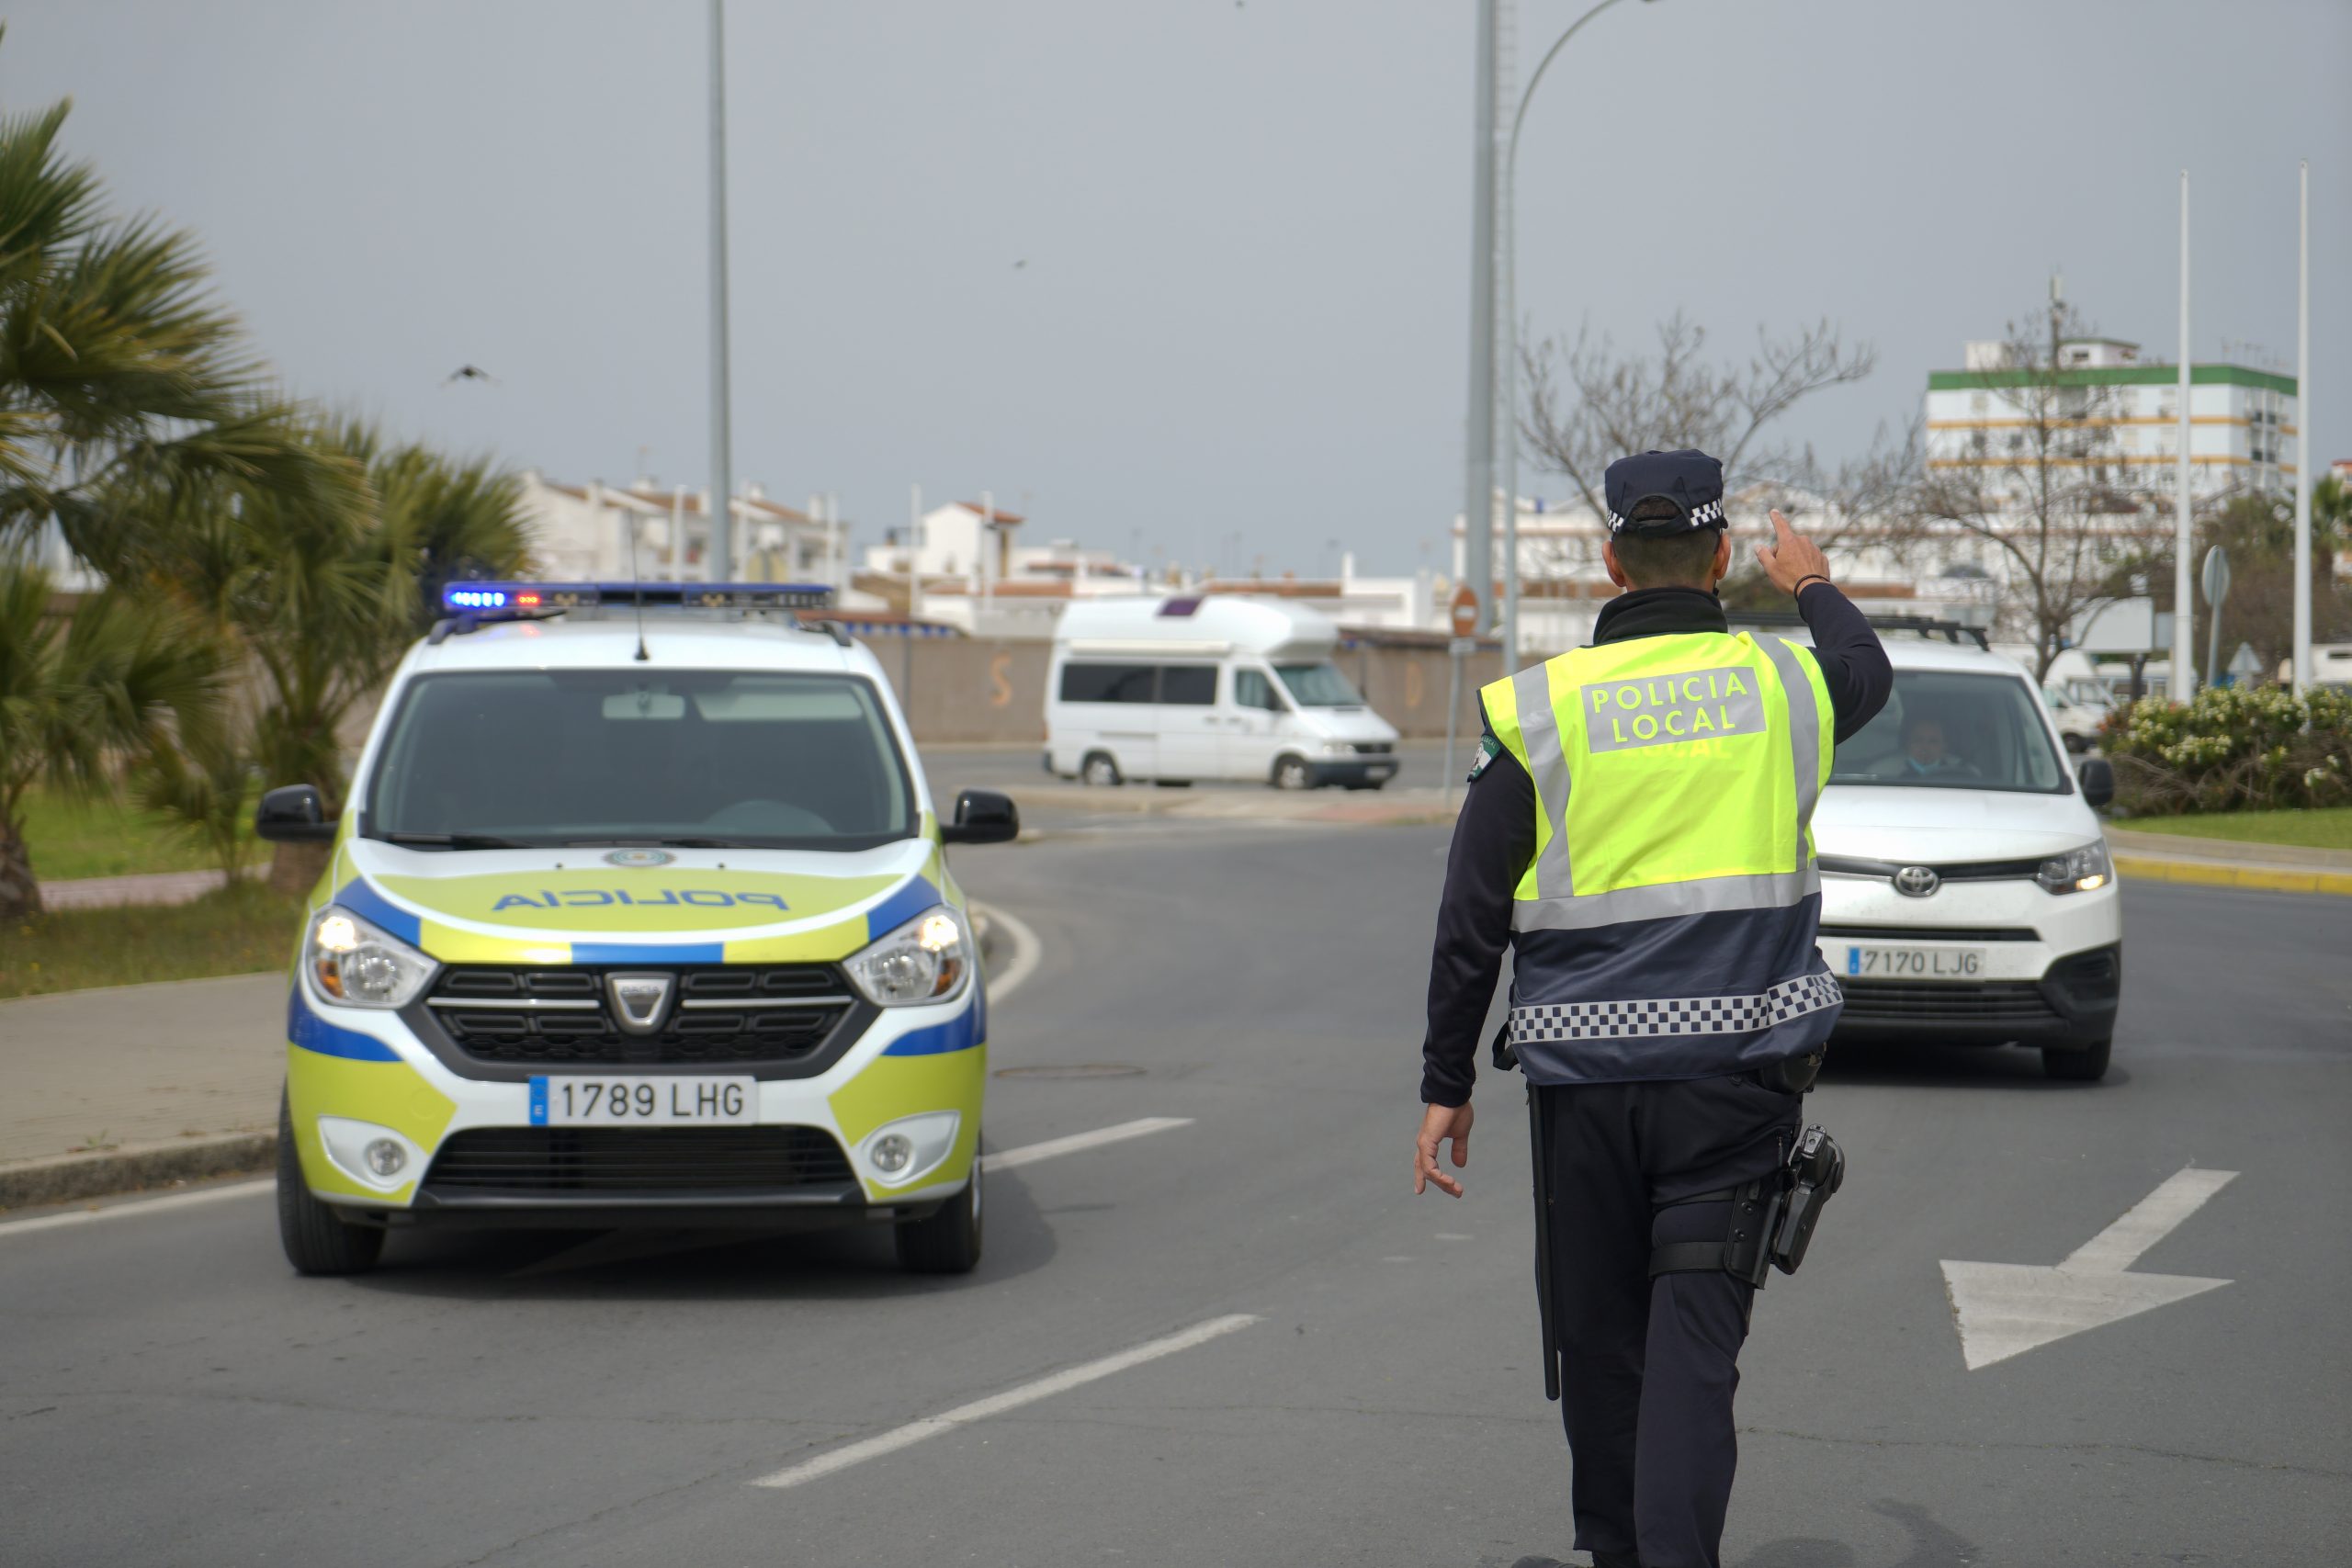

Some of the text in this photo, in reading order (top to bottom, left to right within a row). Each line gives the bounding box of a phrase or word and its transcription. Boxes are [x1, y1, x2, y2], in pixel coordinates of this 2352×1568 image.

[1591, 671, 1747, 714] POLICIA
[1611, 705, 1736, 743] LOCAL
[1865, 951, 1925, 973] 7170
[1933, 953, 1978, 974] LJG
[562, 1082, 743, 1117] 1789 LHG
